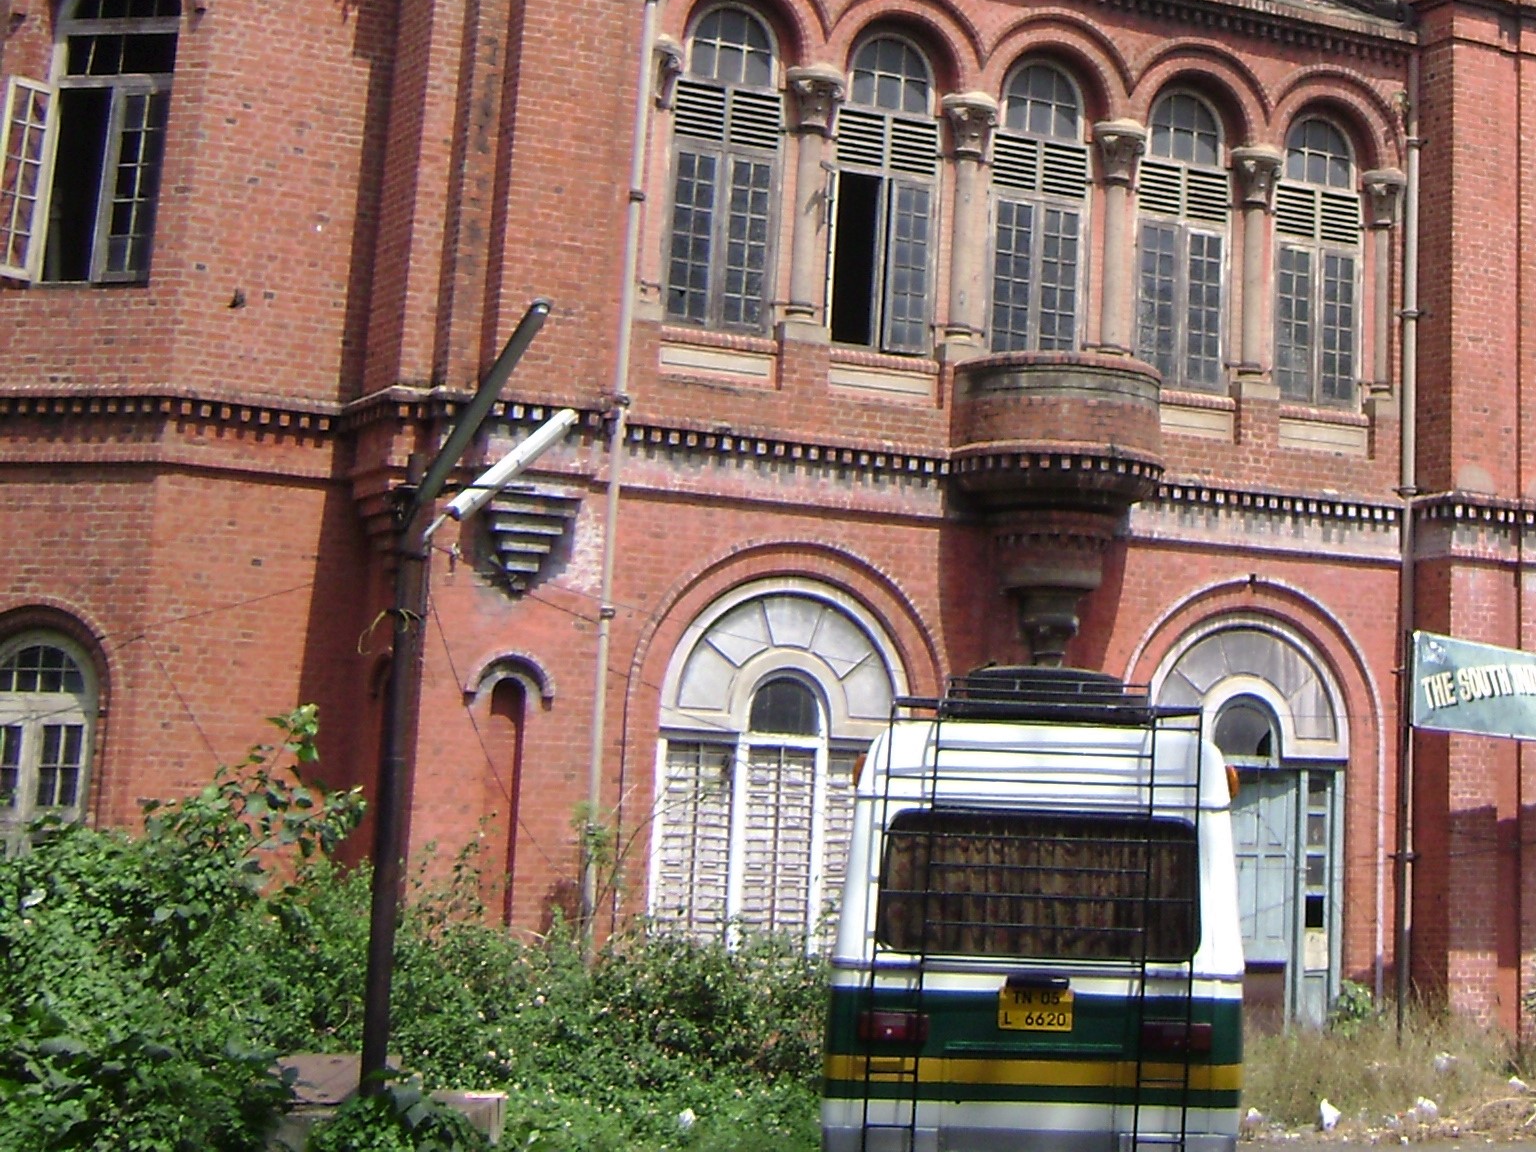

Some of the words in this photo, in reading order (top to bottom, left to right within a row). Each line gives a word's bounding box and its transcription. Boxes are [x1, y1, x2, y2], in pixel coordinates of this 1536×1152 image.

[1421, 672, 1458, 710] THE
[1457, 664, 1514, 703] SOUTH
[1014, 991, 1032, 1004] TN
[1041, 991, 1060, 1005] 05
[1004, 1012, 1012, 1025] L
[1025, 1012, 1066, 1026] 6620
